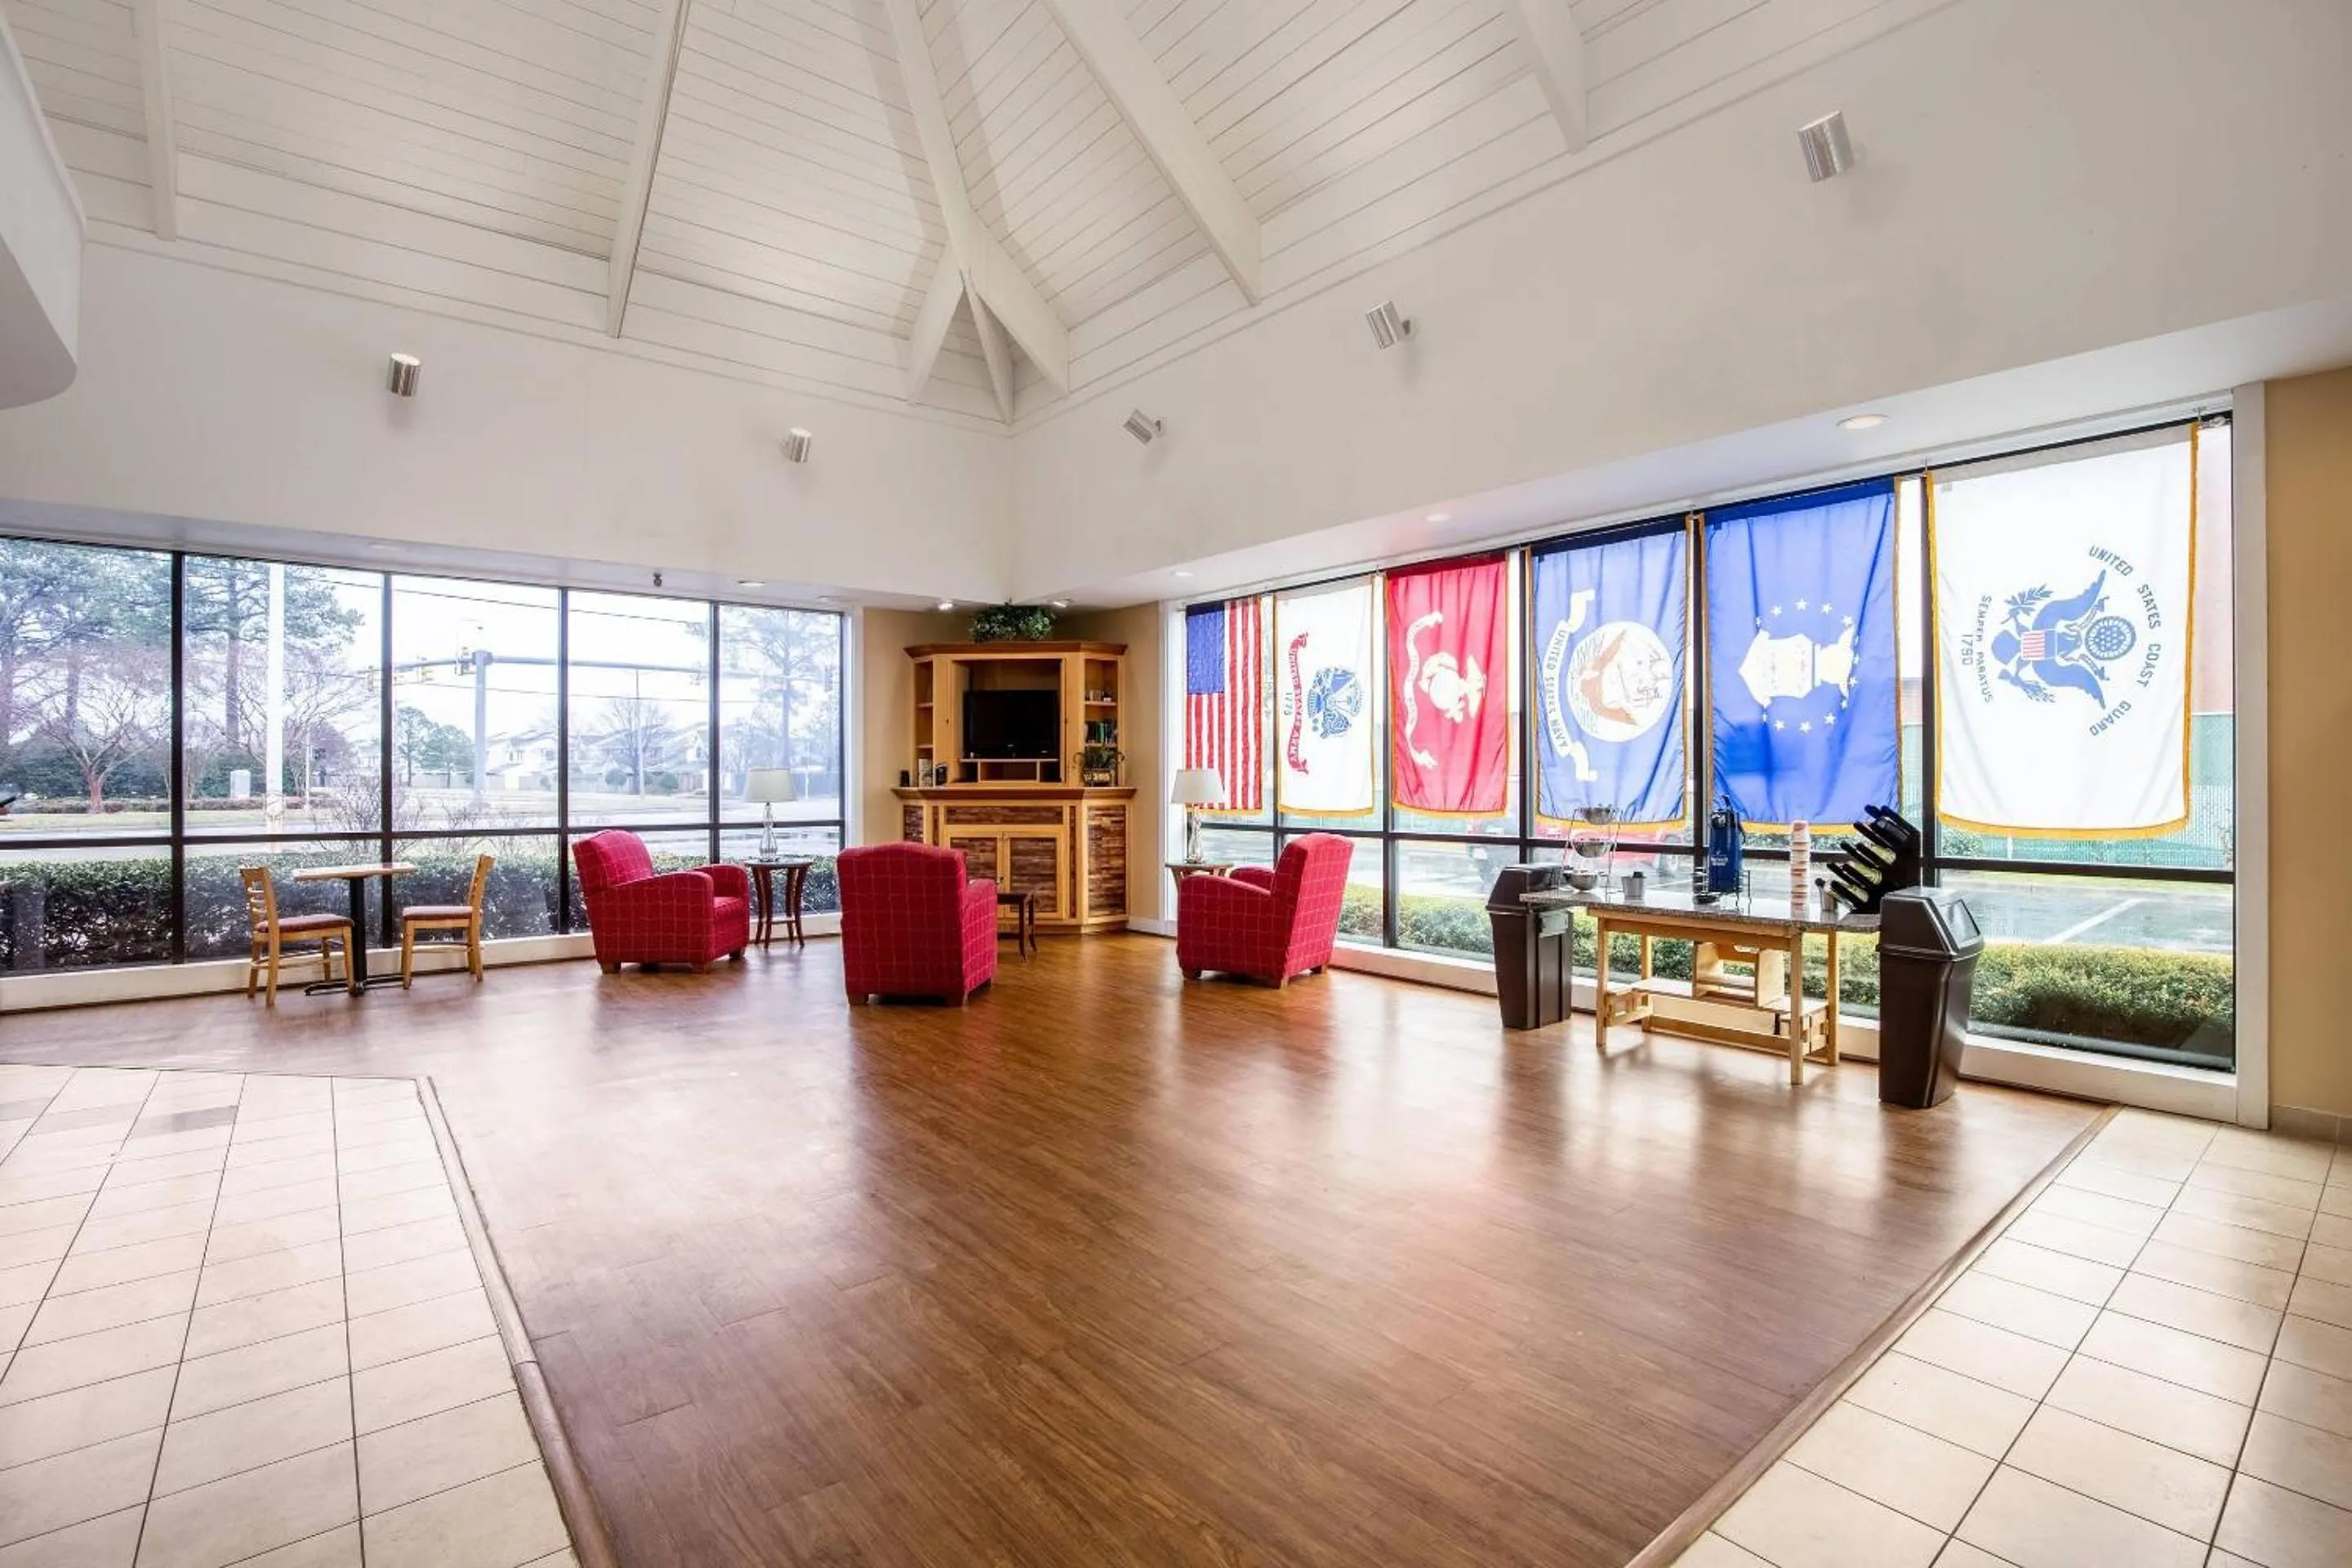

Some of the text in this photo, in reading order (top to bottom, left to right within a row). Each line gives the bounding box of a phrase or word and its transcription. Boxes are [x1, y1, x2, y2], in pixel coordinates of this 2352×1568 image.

[1546, 629, 1567, 670] UNITED
[1961, 634, 1974, 666] 1790
[1976, 595, 1993, 703] SEMPER PARATUS
[2088, 545, 2162, 737] UNITED STATES COAST GUARD
[1551, 718, 1569, 748] NAVY
